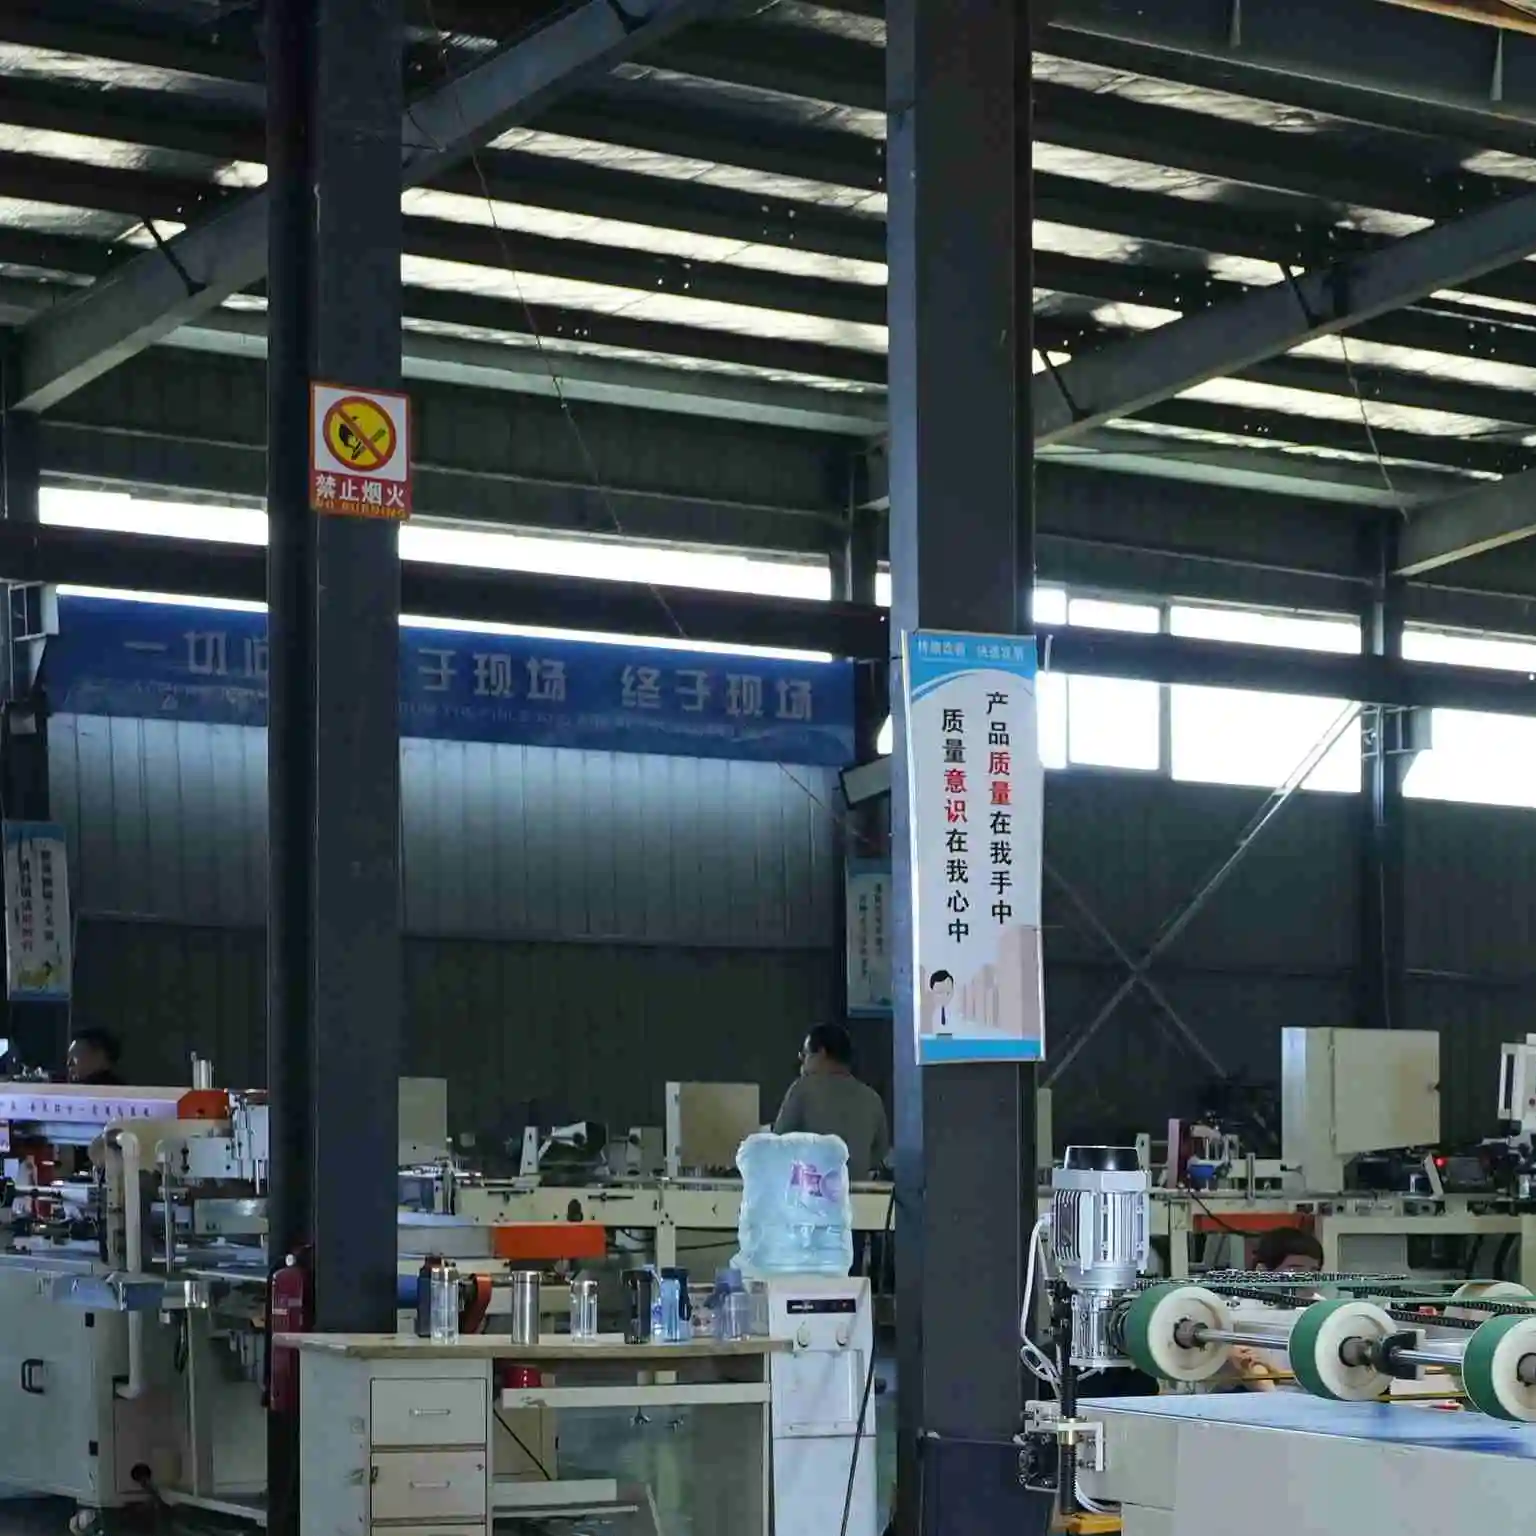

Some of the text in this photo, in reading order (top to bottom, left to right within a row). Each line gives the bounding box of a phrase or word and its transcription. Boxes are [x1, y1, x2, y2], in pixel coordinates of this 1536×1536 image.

[315, 473, 405, 507] 禁止烟火
[941, 707, 970, 944] 质量意识在我心中
[986, 691, 1013, 925] 产品质量在我手中
